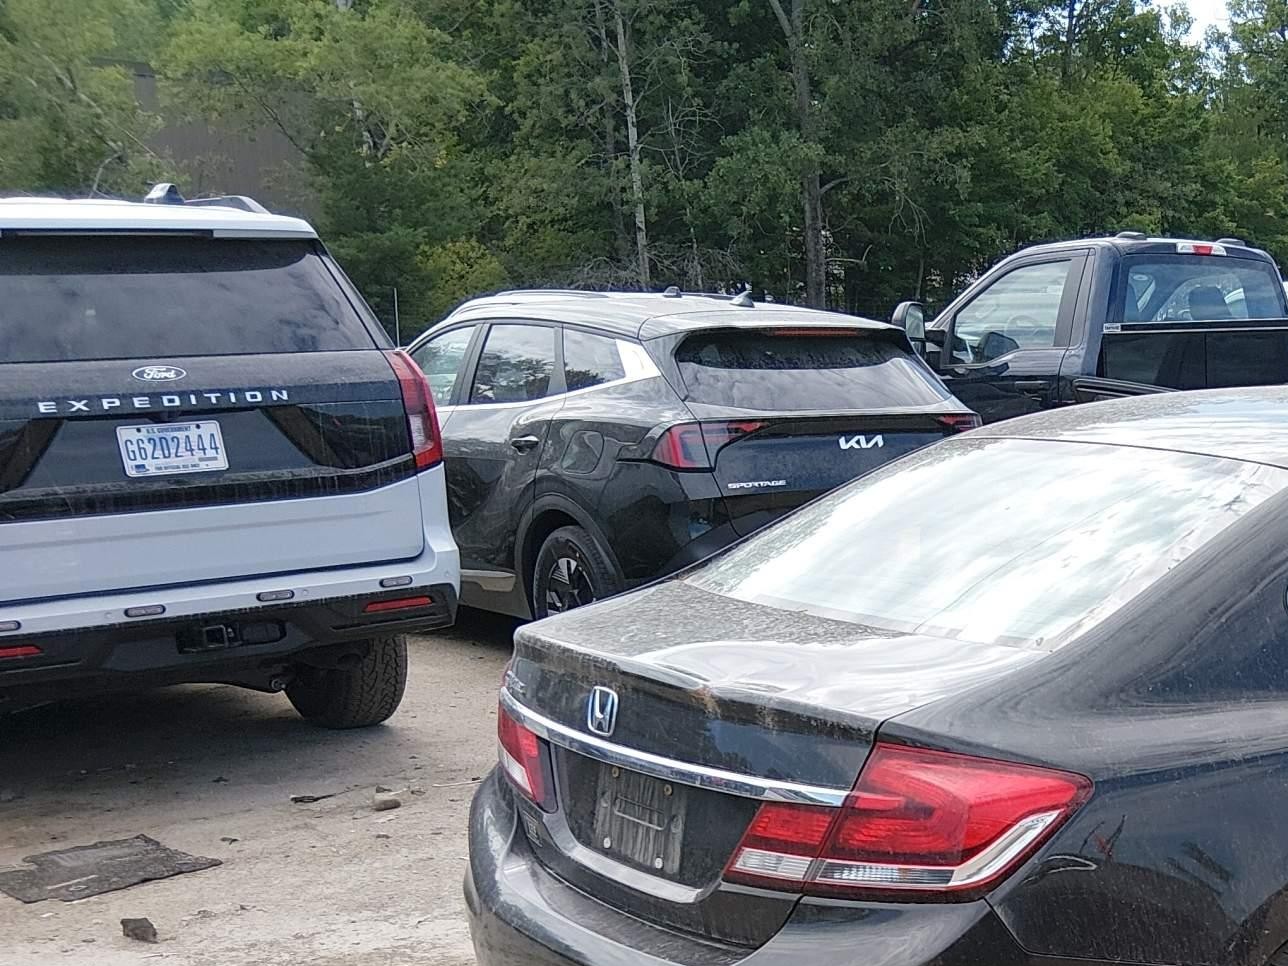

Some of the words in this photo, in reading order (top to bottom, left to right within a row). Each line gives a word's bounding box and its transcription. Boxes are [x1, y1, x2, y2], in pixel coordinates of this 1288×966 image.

[143, 367, 177, 379] Ford
[37, 390, 289, 413] EXPEDITION
[727, 480, 787, 489] SPORTAGE
